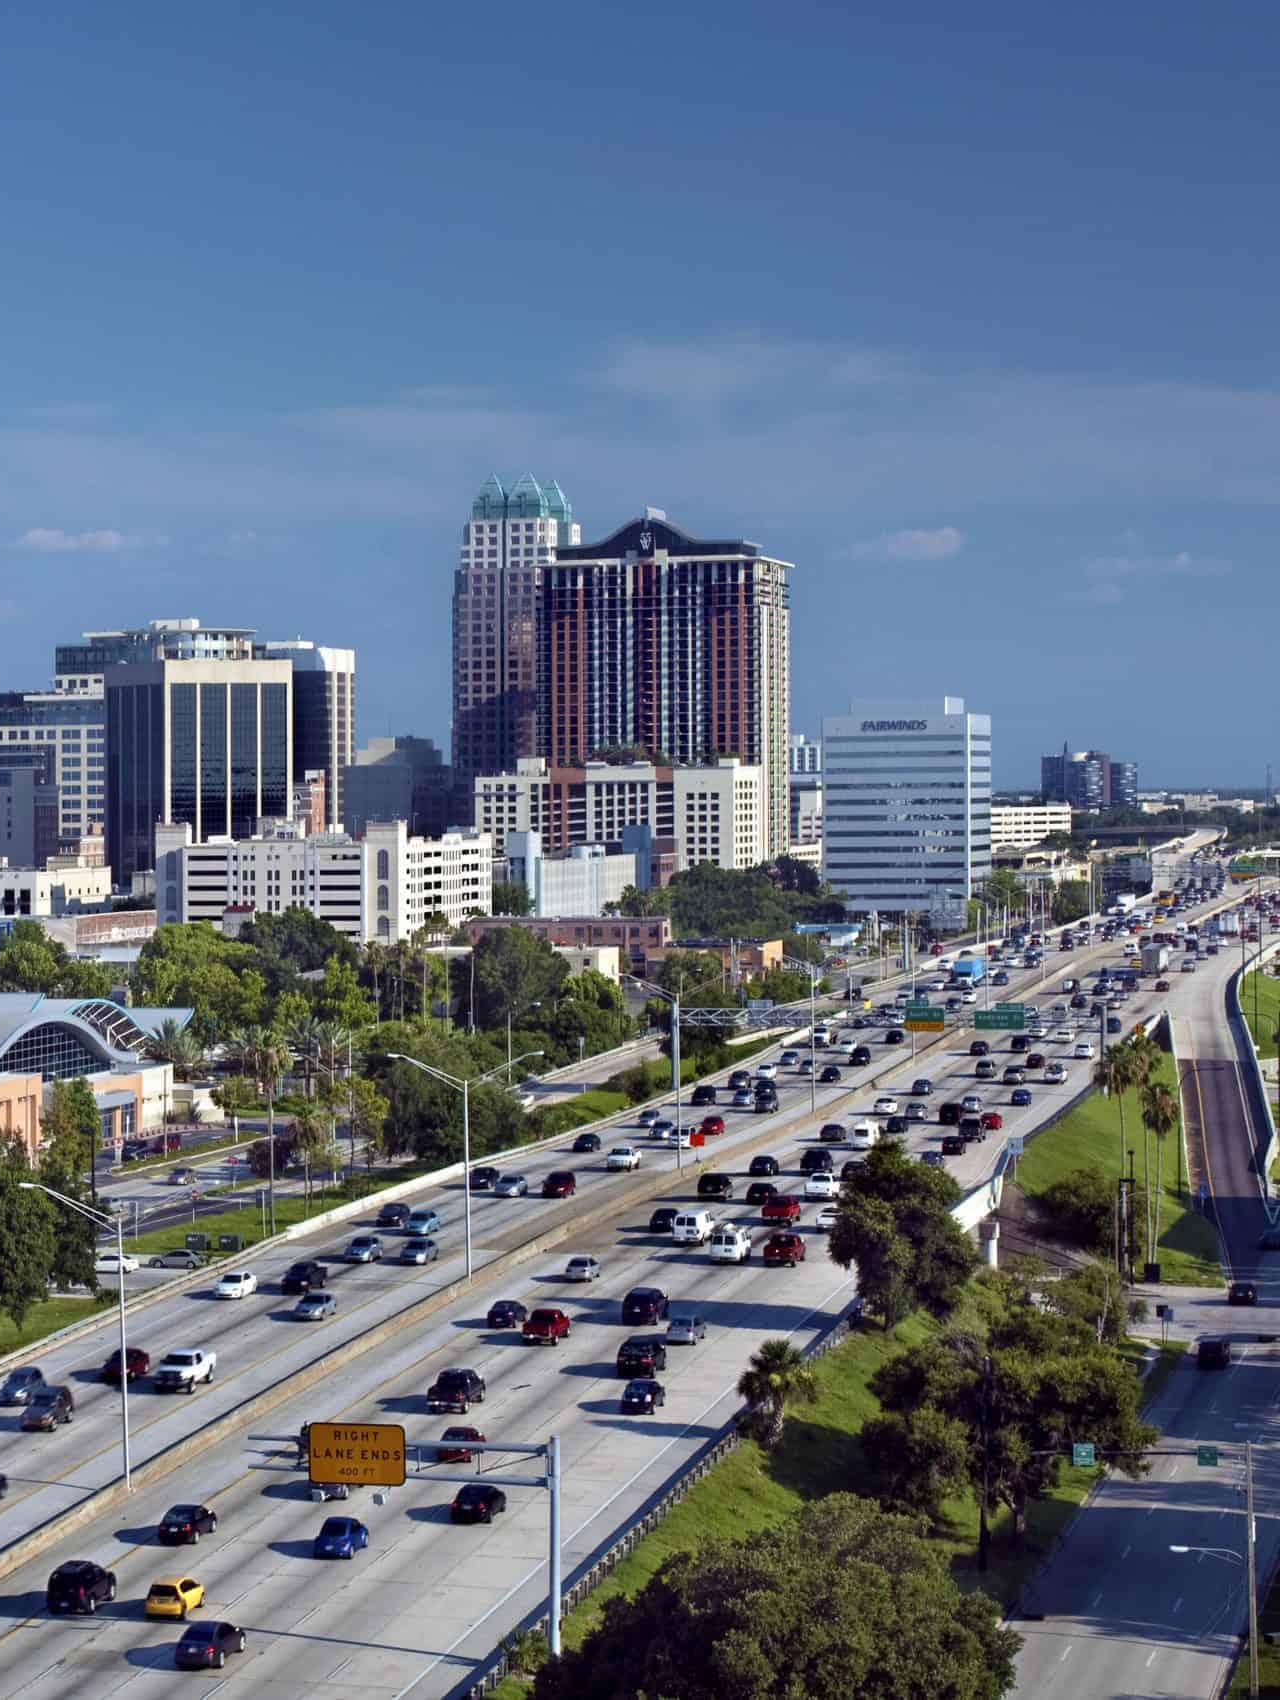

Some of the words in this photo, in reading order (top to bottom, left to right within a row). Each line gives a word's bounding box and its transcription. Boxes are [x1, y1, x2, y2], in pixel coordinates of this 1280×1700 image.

[861, 720, 927, 732] FAIRWINDS
[334, 1431, 379, 1441] RIGHT
[313, 1448, 354, 1459] LANE
[361, 1450, 402, 1461] ENDS
[338, 1468, 359, 1476] 400
[363, 1468, 376, 1476] FT
